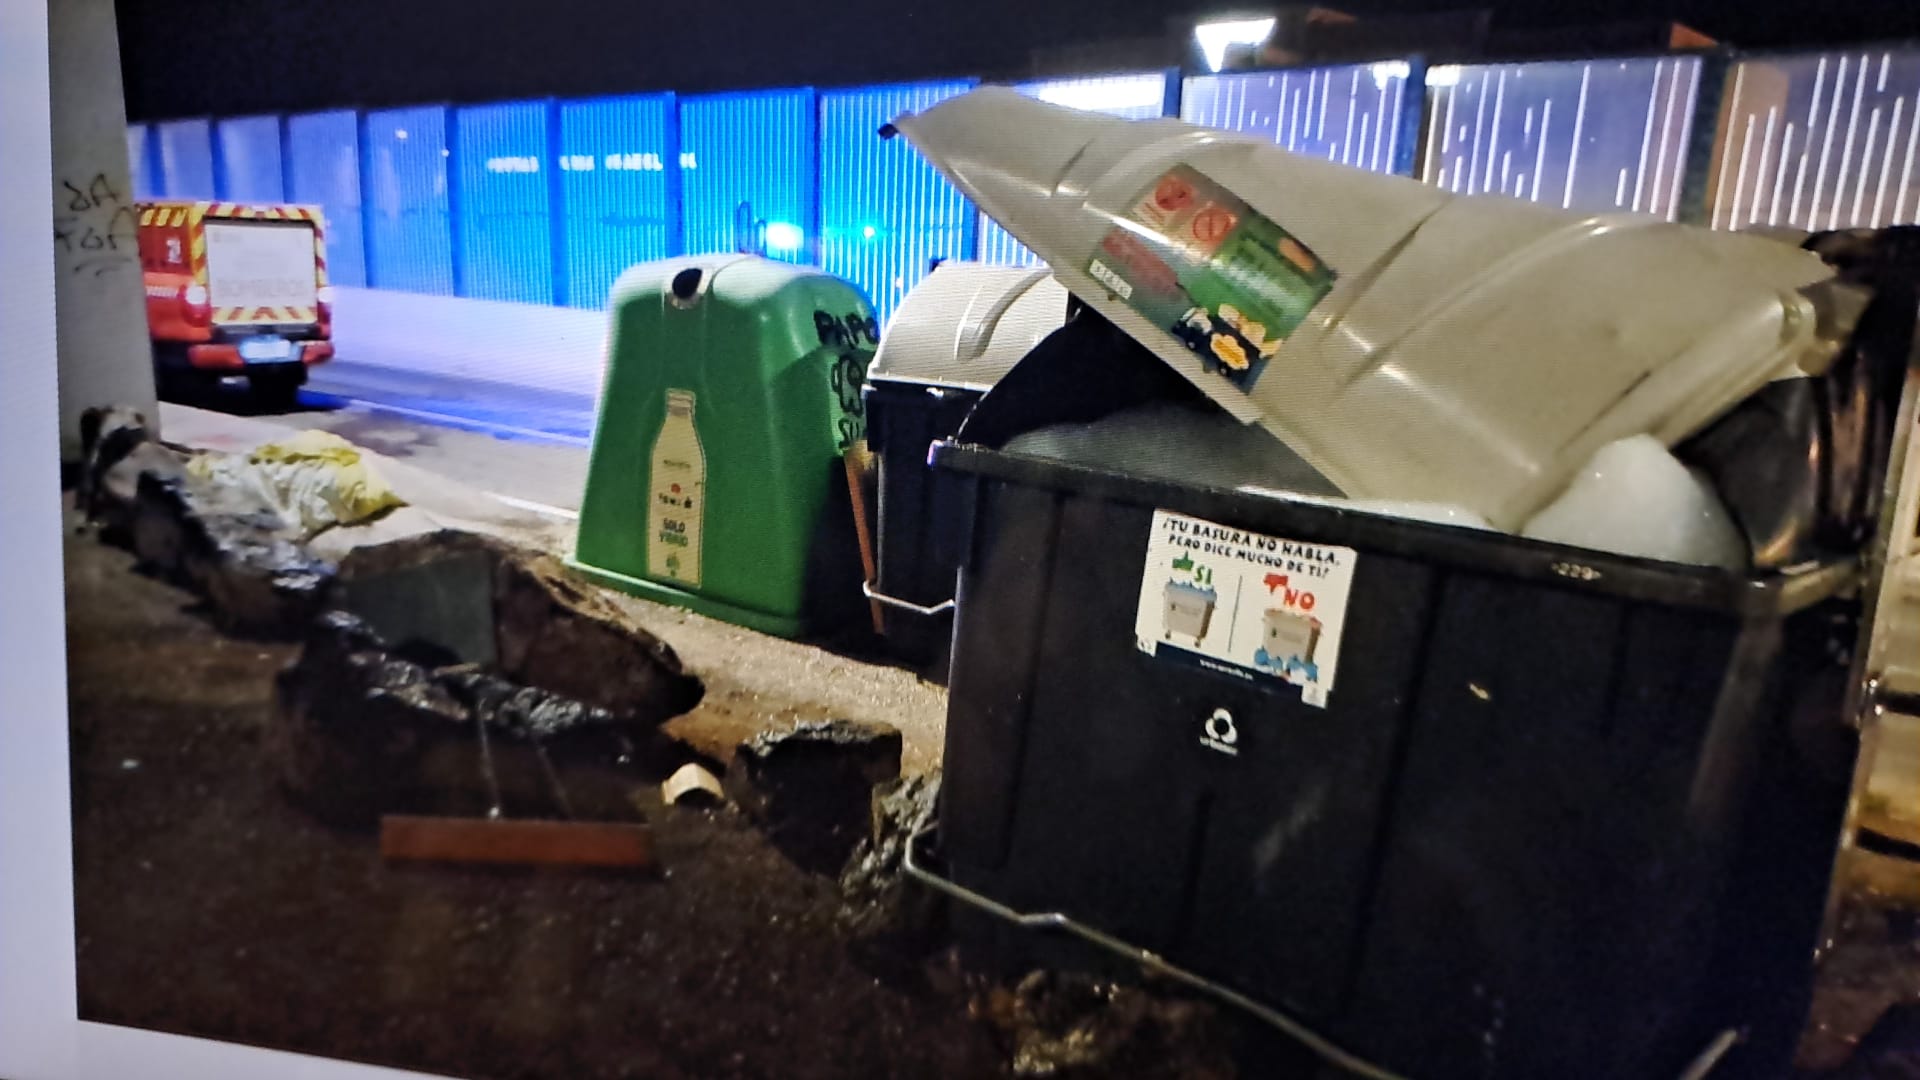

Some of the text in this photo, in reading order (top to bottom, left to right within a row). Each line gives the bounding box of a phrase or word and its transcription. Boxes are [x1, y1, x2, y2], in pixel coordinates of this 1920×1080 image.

[1192, 523, 1251, 547] BASURA
[1256, 536, 1277, 551] NO
[1168, 534, 1201, 550] PERO
[1204, 542, 1231, 557] DICE
[1235, 549, 1283, 568] MUCHO
[1286, 560, 1304, 574] DE
[1283, 587, 1315, 611] NO
